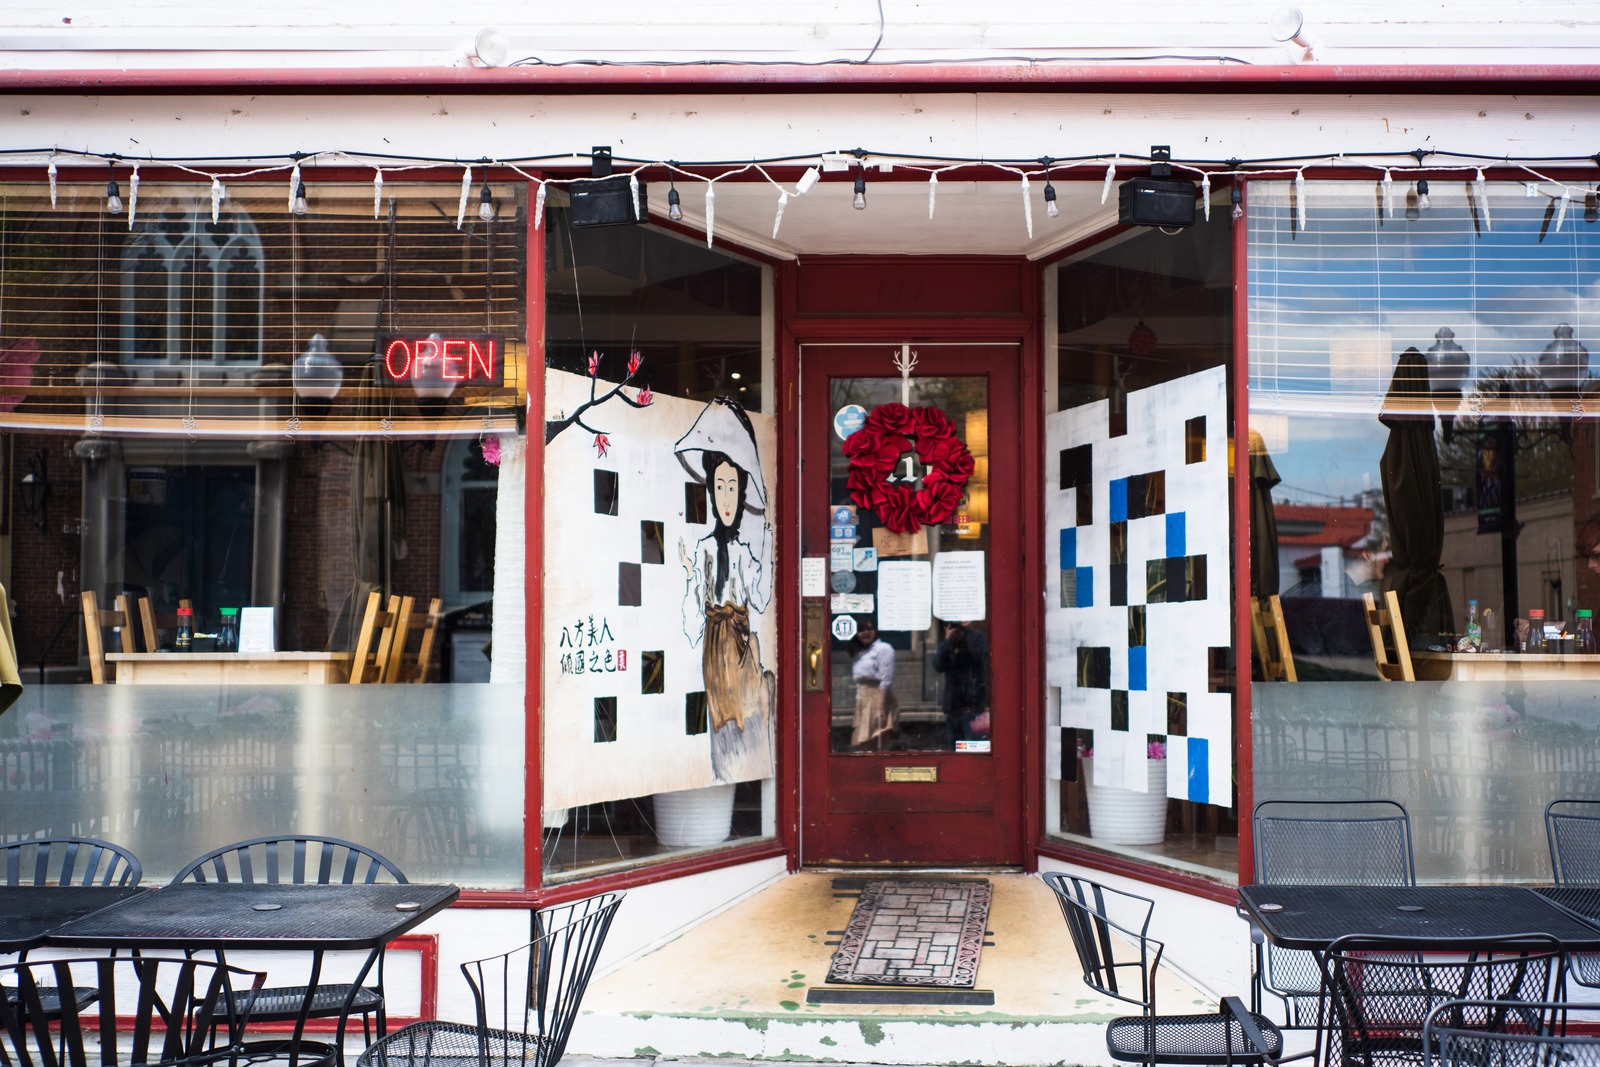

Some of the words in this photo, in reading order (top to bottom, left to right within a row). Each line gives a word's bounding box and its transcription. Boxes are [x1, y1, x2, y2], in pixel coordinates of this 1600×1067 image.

[385, 339, 496, 381] OPEN
[560, 613, 615, 648] 八方美人
